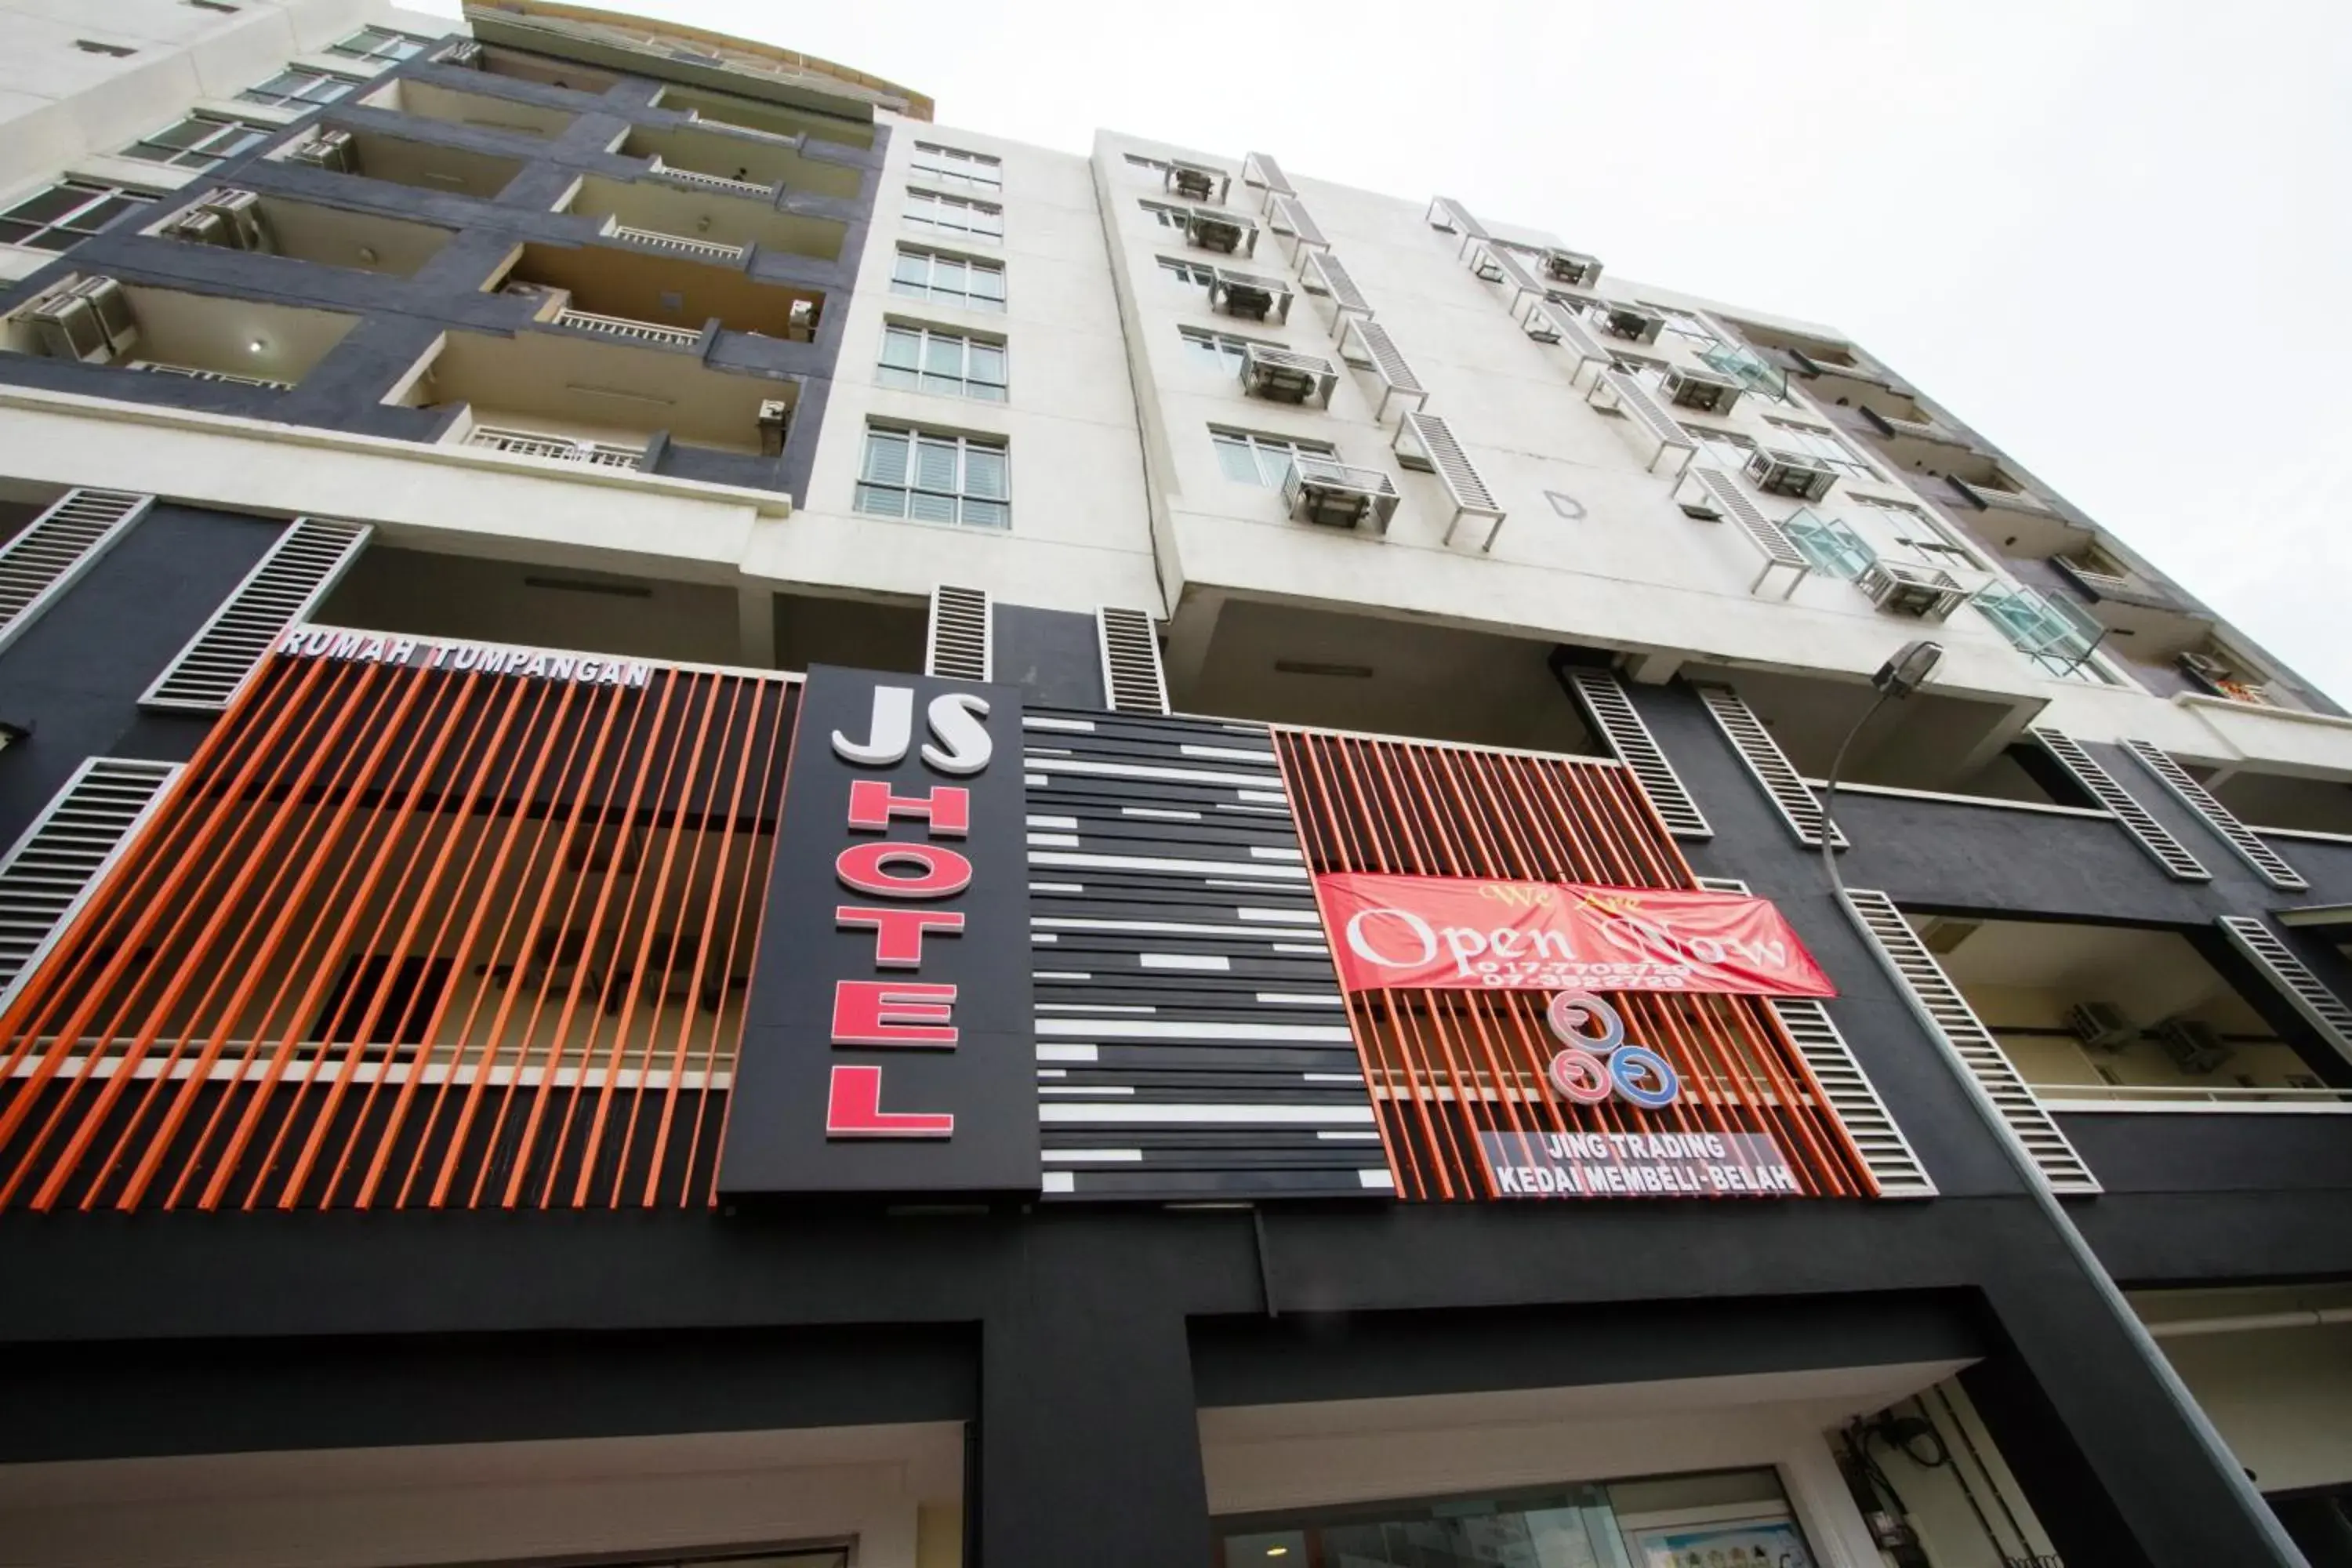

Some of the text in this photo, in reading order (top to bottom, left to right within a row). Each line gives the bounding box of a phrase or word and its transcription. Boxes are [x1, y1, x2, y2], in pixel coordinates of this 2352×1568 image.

[277, 629, 648, 687] RUMAH TUMPANGAN
[831, 685, 993, 774] JS
[1479, 884, 1551, 907] We
[826, 780, 973, 1137] HOTEL
[1346, 909, 1786, 977] Open Now
[1548, 1133, 1726, 1159] JING TRADING
[1496, 1164, 1795, 1193] KEDAI MEMBELI-BELAH
